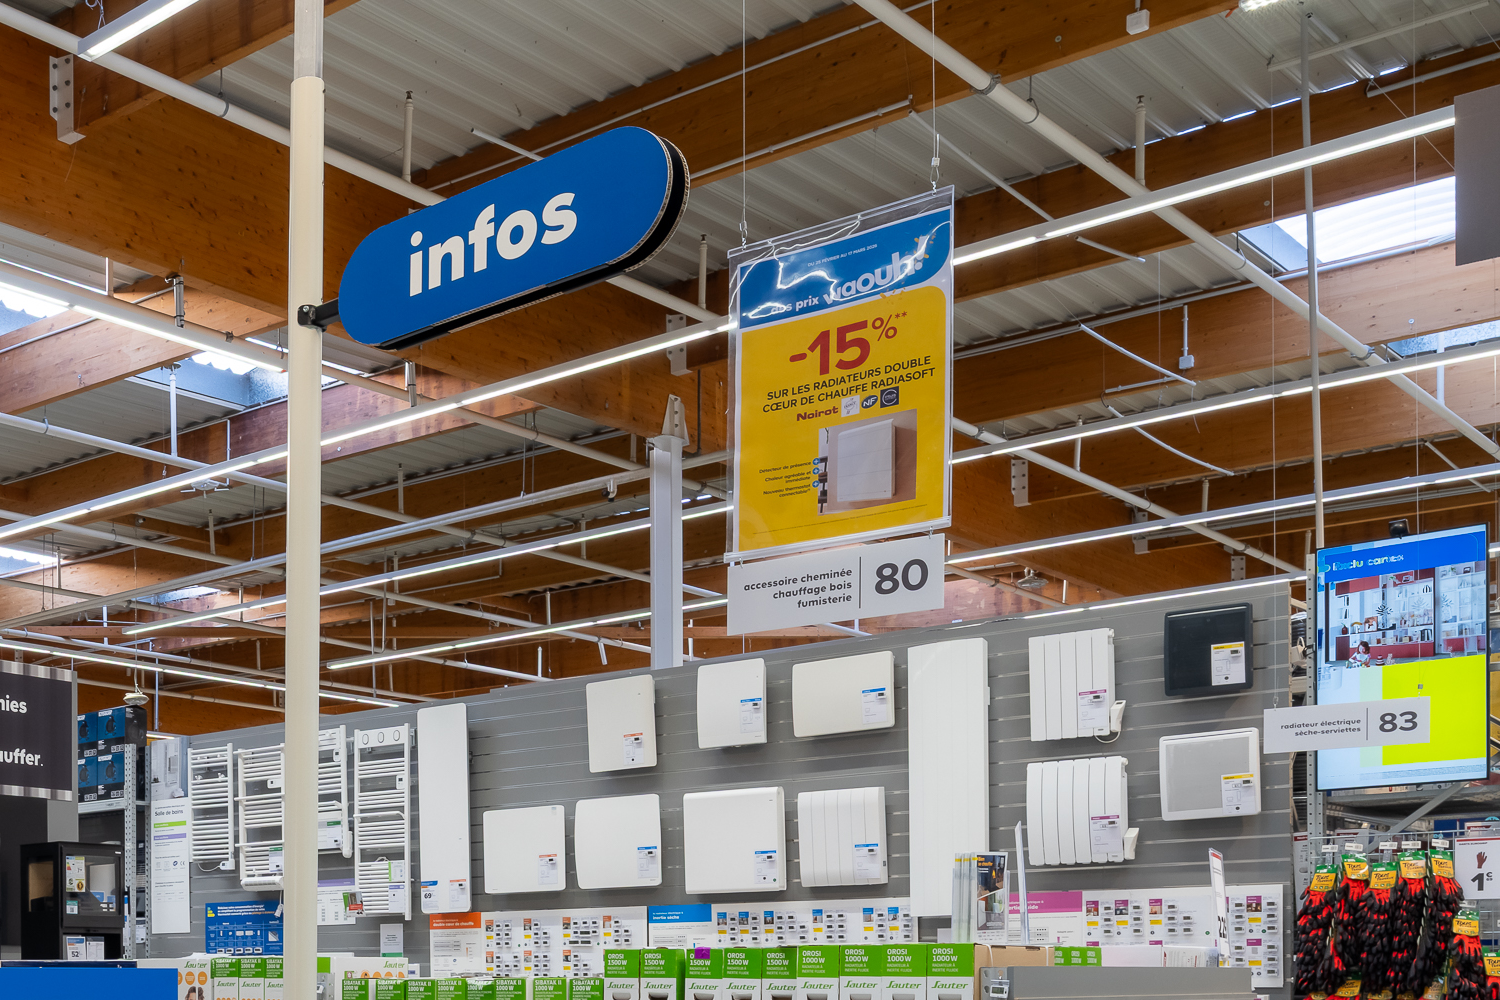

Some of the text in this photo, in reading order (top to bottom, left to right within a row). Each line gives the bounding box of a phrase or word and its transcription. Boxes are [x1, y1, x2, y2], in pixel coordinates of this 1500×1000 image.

[408, 191, 579, 298] infos
[796, 296, 819, 311] prix
[767, 355, 931, 400] SUR LES RADIATEURS DOUBLE
[763, 368, 935, 413] CŒUR DE CHAUFFE RADIASOFT
[797, 406, 839, 421] Noirot
[744, 558, 928, 595] accessoire cheminée 80
[773, 581, 852, 600] chauffage bois
[797, 594, 852, 609] fumisterie
[1280, 710, 1418, 733] radiateur électrique 83
[1294, 726, 1361, 736] sèche-serviettes
[1471, 872, 1484, 891] 1
[801, 980, 834, 989] Sauter
[844, 980, 878, 989] Sauter
[886, 980, 921, 989] Sauter
[931, 980, 968, 989] Sauter
